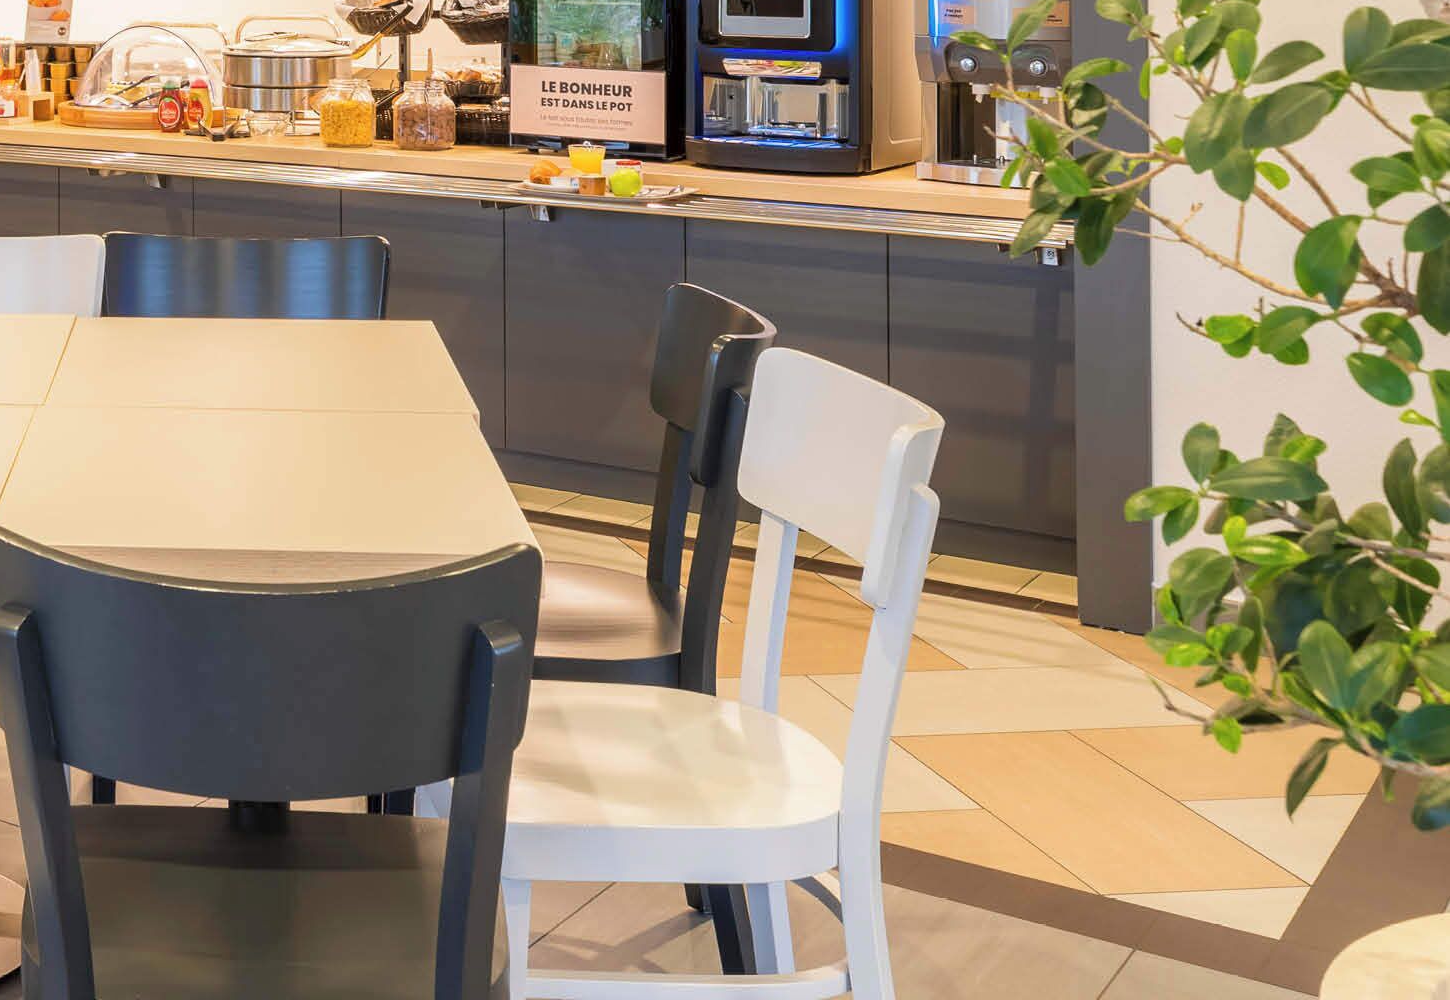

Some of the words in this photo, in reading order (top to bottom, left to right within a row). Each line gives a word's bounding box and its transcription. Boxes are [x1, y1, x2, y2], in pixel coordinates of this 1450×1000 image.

[541, 81, 556, 93] LE
[559, 82, 633, 98] BONHEUR
[541, 97, 560, 107] EST
[562, 99, 594, 110] DANS
[596, 101, 608, 110] LE
[610, 103, 633, 112] POT
